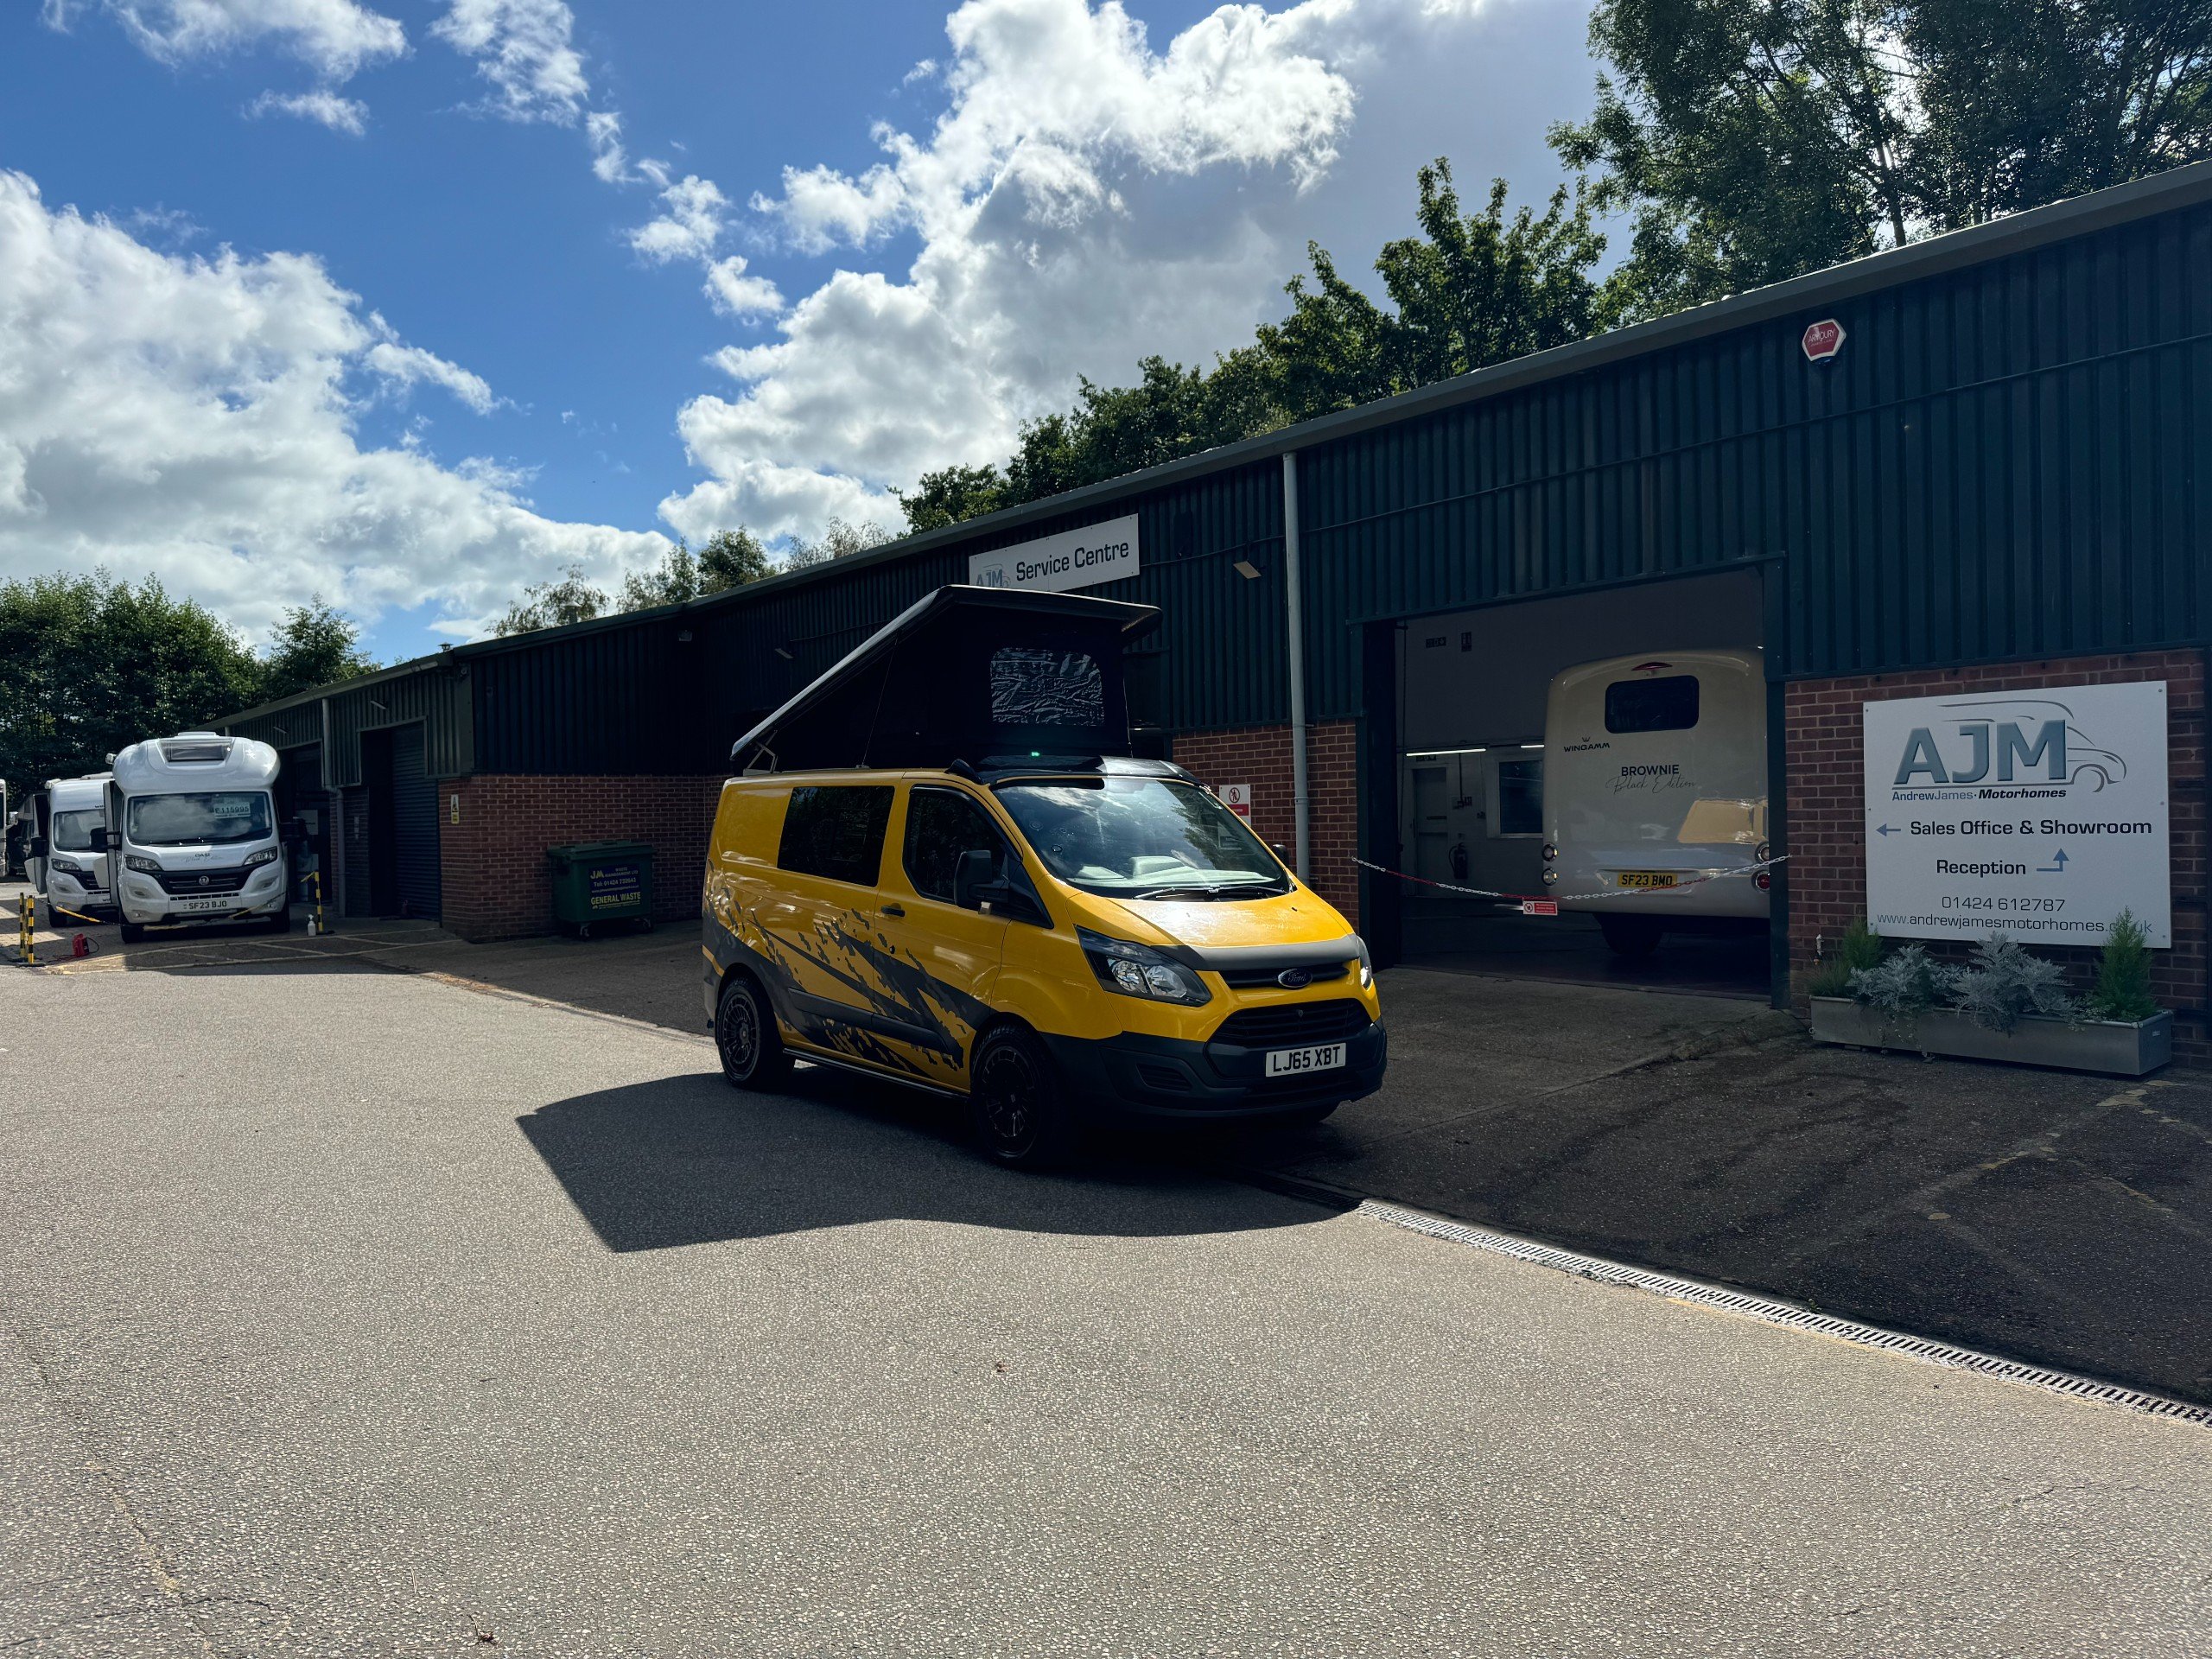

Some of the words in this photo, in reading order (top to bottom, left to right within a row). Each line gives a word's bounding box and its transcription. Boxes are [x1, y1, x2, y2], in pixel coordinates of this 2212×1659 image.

[1808, 328, 1835, 343] ARMOURY
[1016, 555, 1070, 582] Service
[1074, 542, 1129, 569] Centre
[1563, 741, 1611, 753] WINGAMM
[1893, 719, 2067, 785] AJM
[1621, 765, 1680, 777] BROWNIE
[1605, 775, 1649, 795] Black
[1651, 773, 1696, 794] Edition
[1910, 820, 1955, 836] Sales
[1961, 820, 2013, 836] Office
[2019, 820, 2035, 835] &
[2040, 819, 2152, 835] Showroom
[1936, 859, 2027, 878] Reception
[1621, 874, 1649, 886] SF23
[1651, 875, 1674, 886] BMO
[188, 901, 210, 910] SF23
[591, 894, 620, 905] GENERAL
[620, 892, 641, 901] WASTE
[1942, 896, 1993, 910] 01424
[1998, 898, 2066, 912] 612787
[1877, 913, 2154, 934] www.andrewjamesmotorhomes.cuk
[1287, 971, 1307, 983] Ford
[1273, 1050, 1311, 1072] LJ65
[1314, 1046, 1341, 1067] XBT
